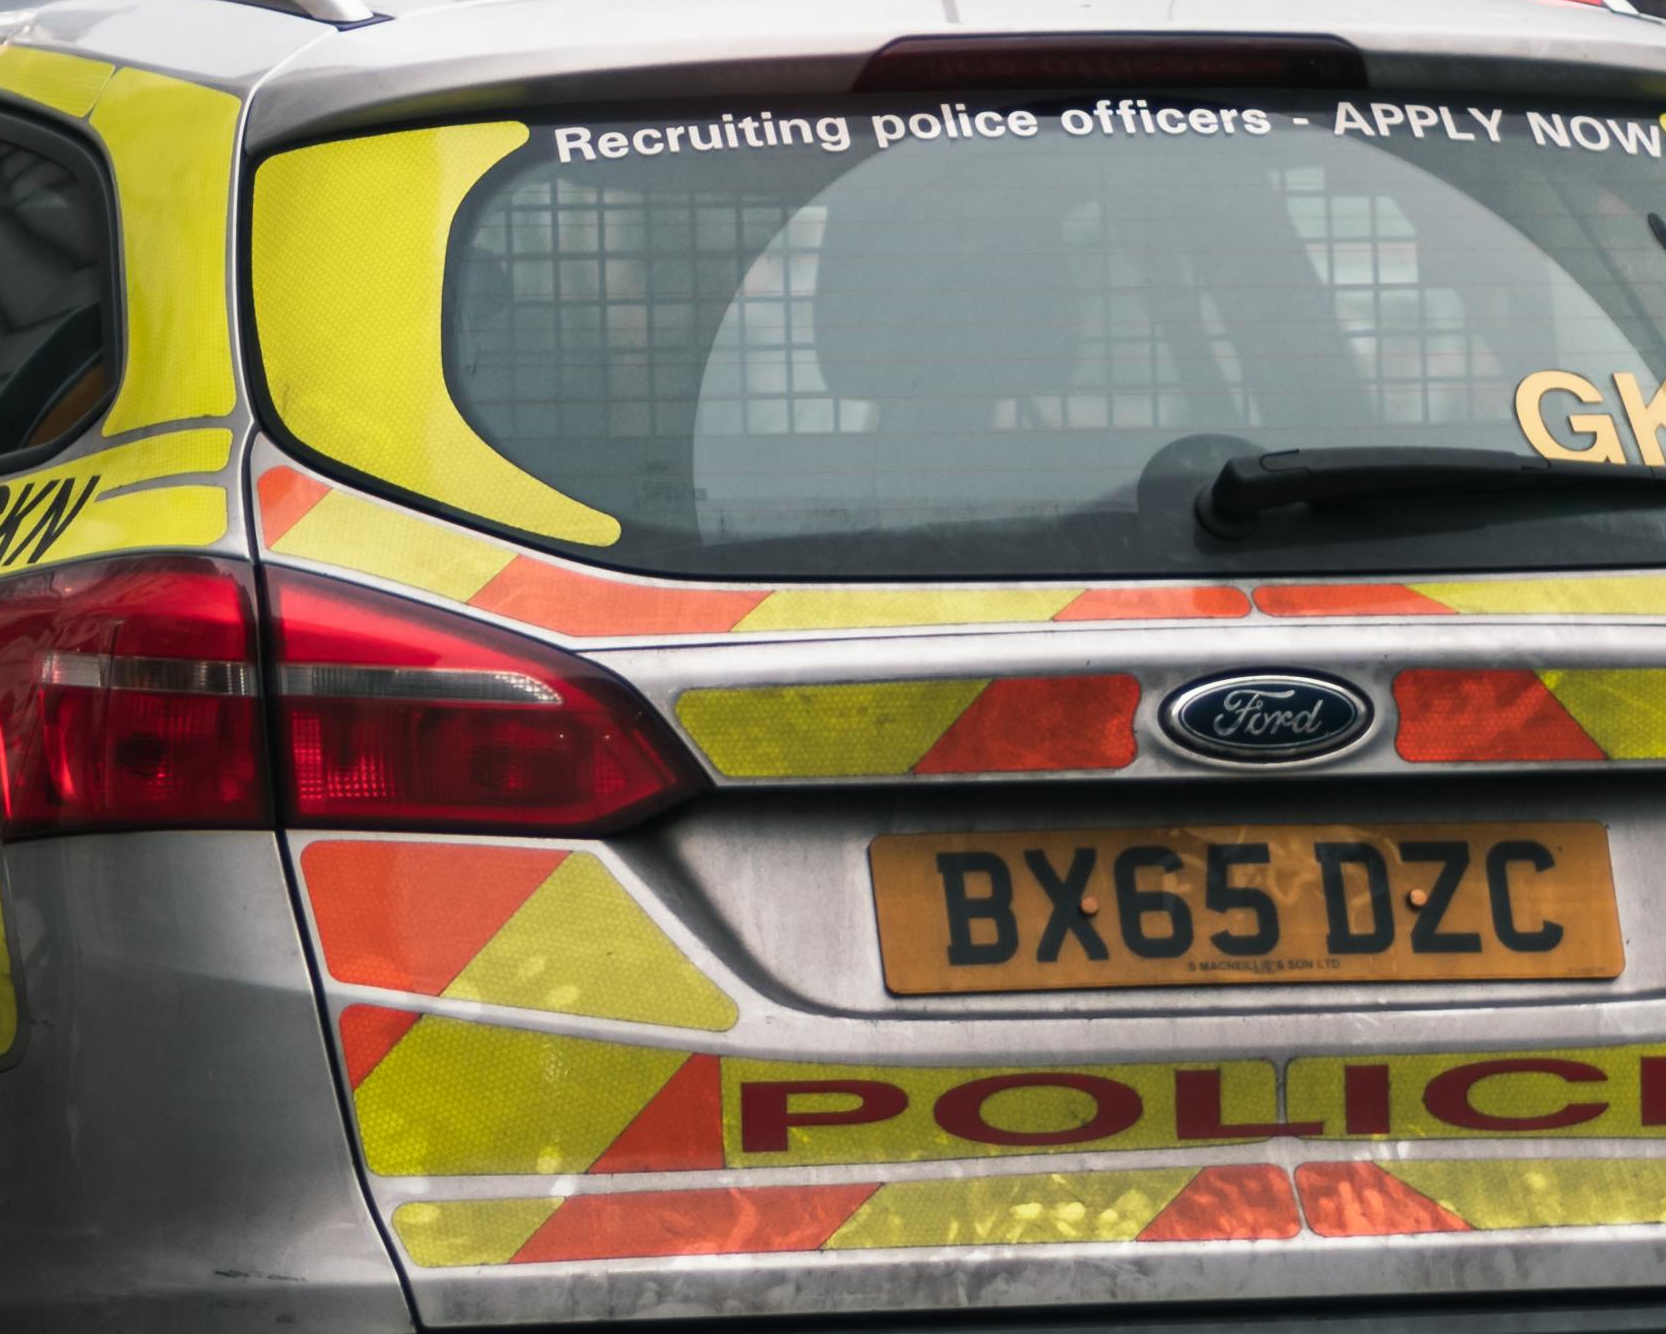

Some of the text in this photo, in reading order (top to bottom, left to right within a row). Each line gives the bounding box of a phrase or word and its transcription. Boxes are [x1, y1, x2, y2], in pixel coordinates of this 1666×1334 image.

[553, 111, 852, 164] Recruiting
[870, 102, 1039, 150] police
[1060, 99, 1272, 137] officers
[1333, 101, 1504, 144] APPLY
[1526, 110, 1664, 158] NOW
[1213, 689, 1324, 737] Ford
[935, 838, 1564, 967] BX65 DZC
